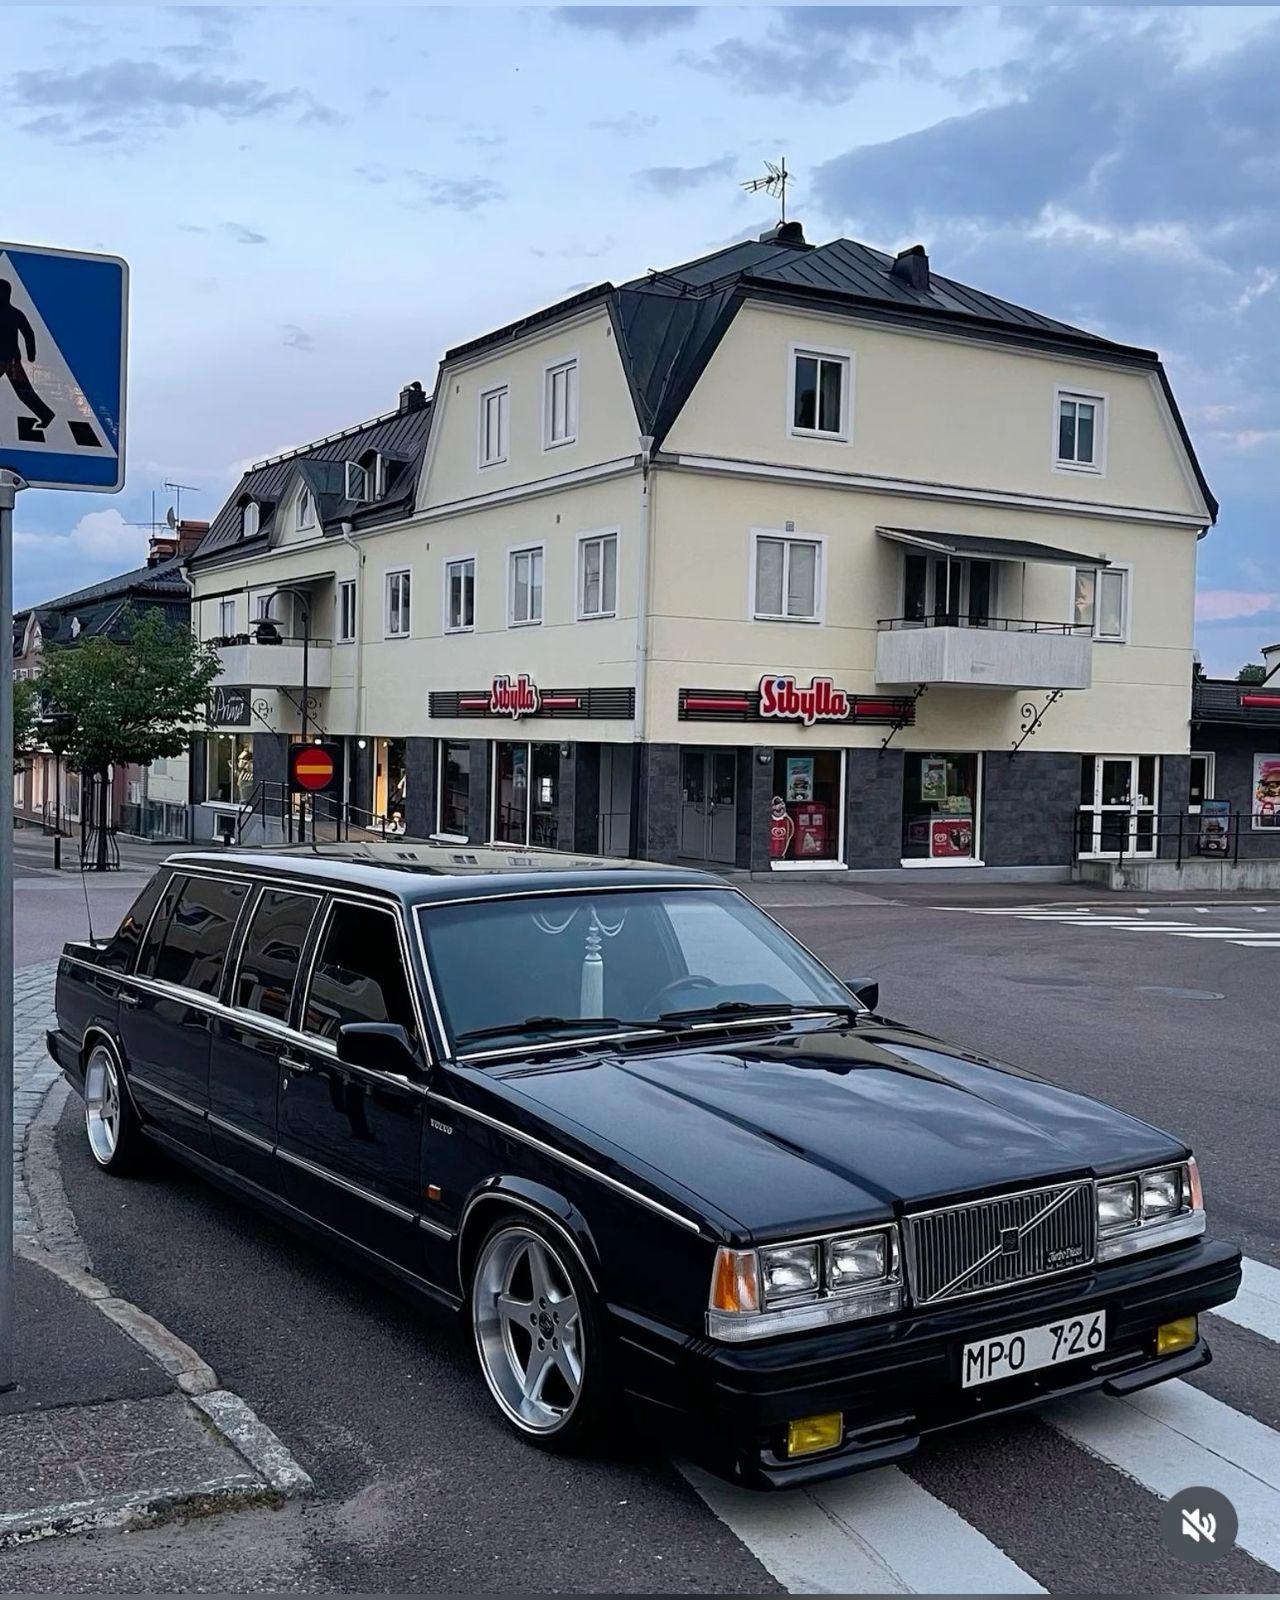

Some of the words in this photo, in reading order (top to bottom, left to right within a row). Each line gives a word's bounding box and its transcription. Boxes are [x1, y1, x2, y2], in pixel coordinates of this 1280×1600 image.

[492, 679, 535, 717] Sibylla
[763, 679, 847, 721] Sibylla
[430, 1118, 453, 1135] VOLVO
[966, 1336, 1026, 1382] MPO
[1050, 1315, 1102, 1360] 726
